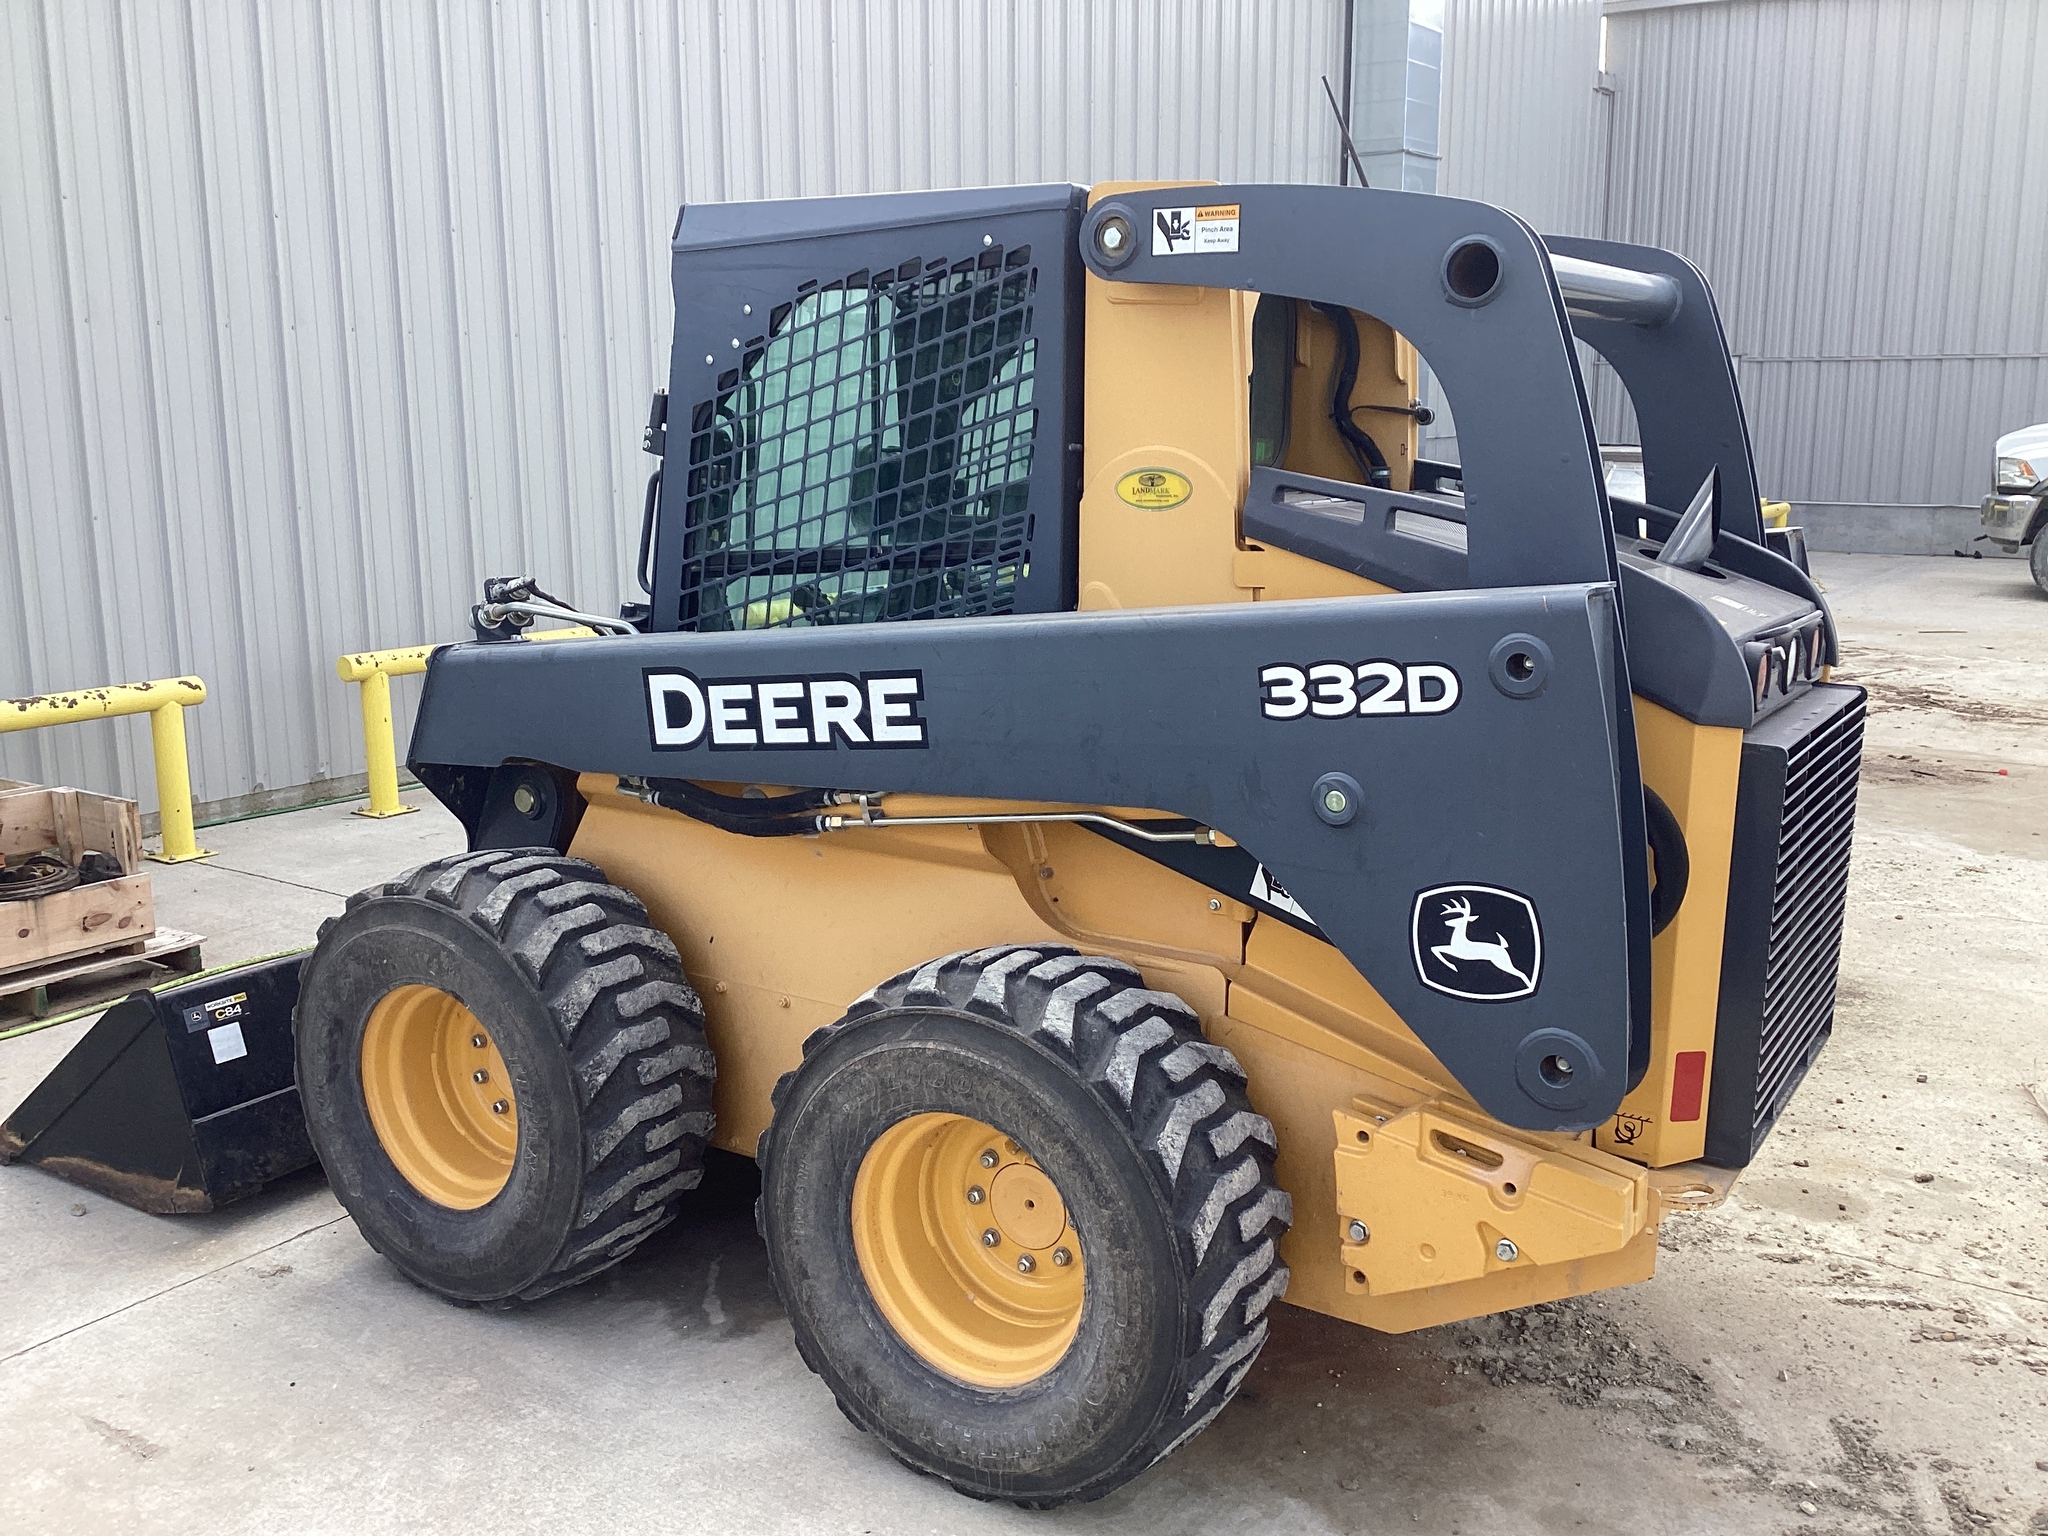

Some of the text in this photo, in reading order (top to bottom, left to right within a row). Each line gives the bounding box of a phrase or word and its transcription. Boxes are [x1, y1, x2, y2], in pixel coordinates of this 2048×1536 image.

[1204, 209, 1236, 217] WARNING
[1261, 662, 1459, 718] 332D
[647, 673, 923, 745] DEERE
[233, 994, 246, 1002] PRO
[215, 1004, 242, 1019] C84
